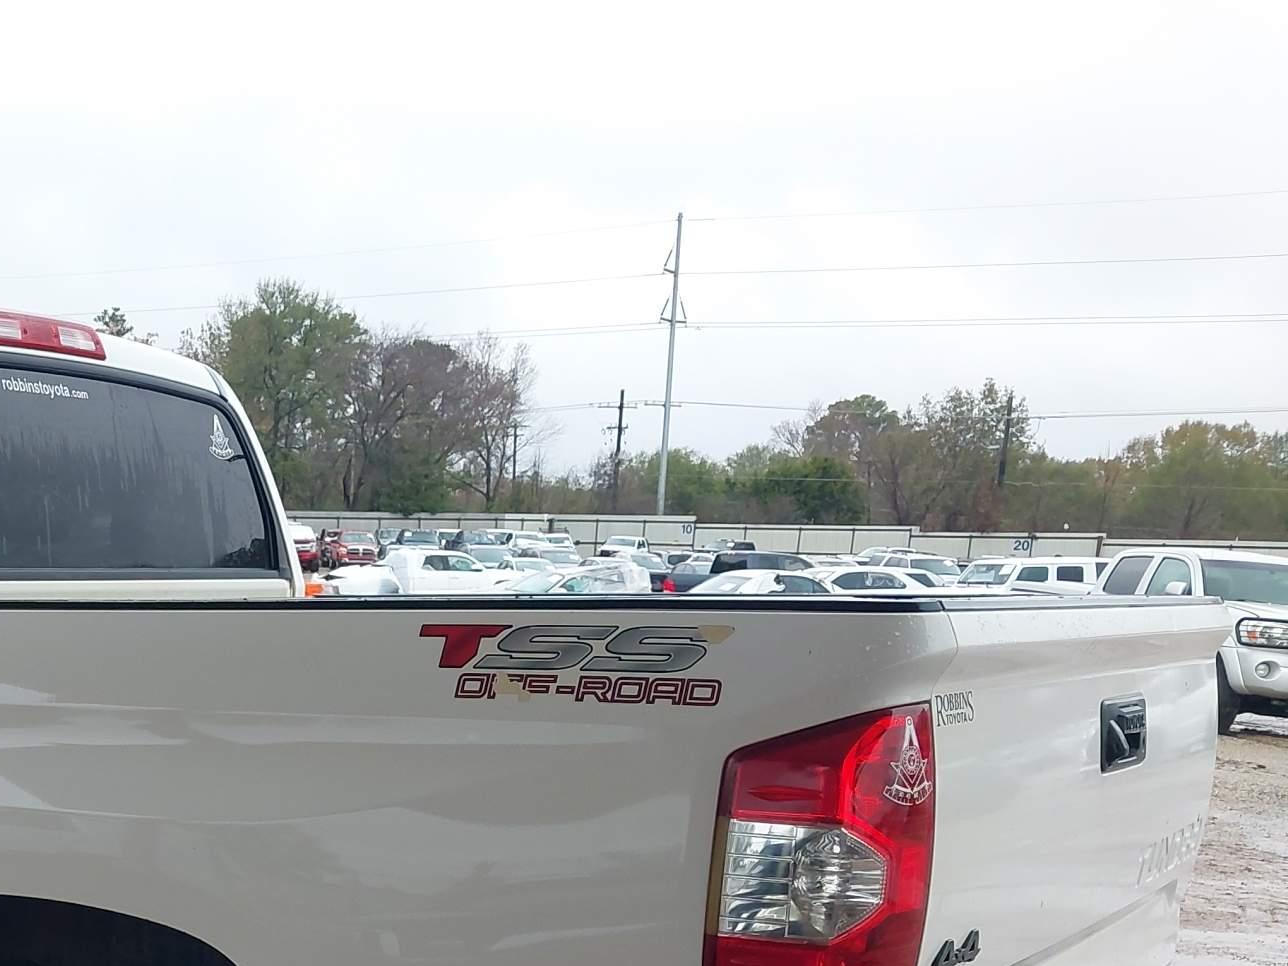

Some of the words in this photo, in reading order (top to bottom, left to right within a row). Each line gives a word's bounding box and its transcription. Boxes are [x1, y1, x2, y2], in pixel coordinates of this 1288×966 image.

[1, 377, 89, 400] robbinstoyota.com
[682, 524, 693, 535] 10
[1013, 540, 1030, 551] 20
[419, 624, 734, 673] TSS
[935, 691, 974, 727] ROBBINS
[946, 711, 968, 725] TOYOTA
